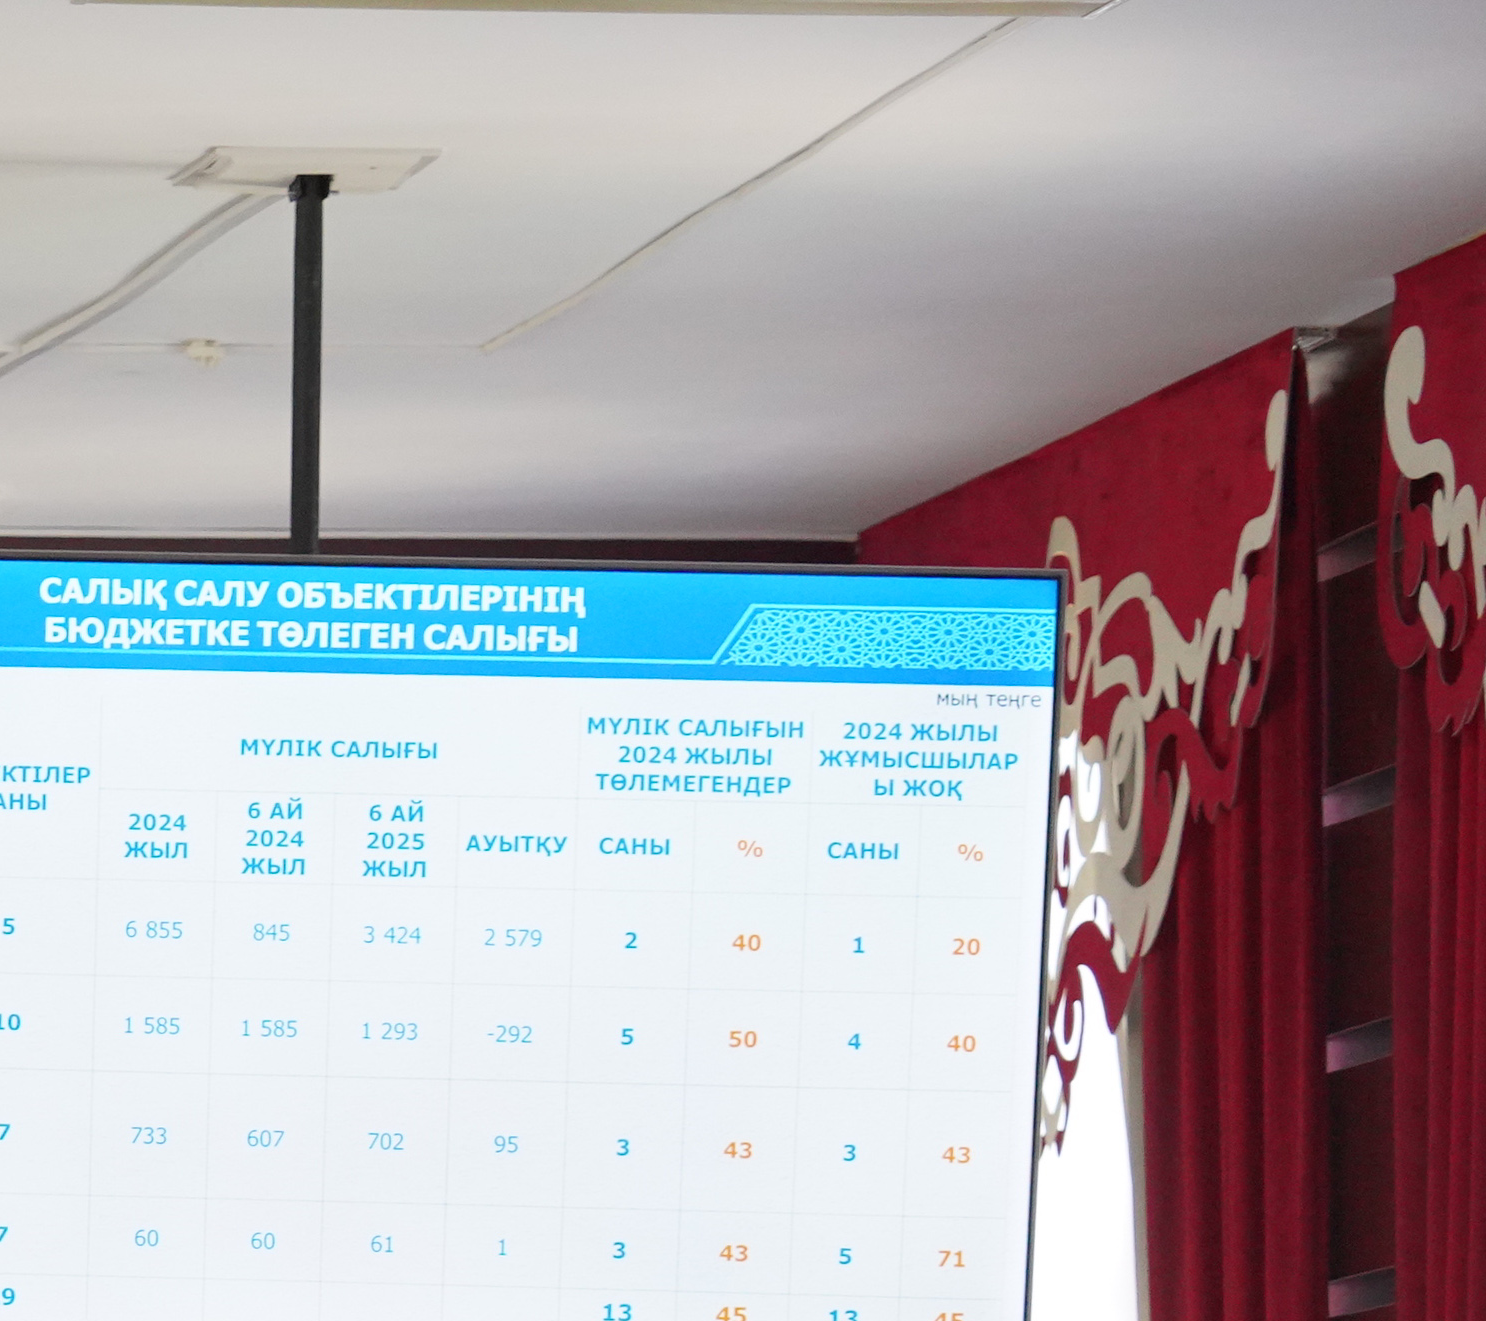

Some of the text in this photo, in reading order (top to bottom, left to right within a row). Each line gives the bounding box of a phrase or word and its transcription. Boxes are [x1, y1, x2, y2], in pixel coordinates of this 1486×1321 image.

[39, 577, 586, 619] САЛЫҚ САЛУ ОБЪЕКТІЛЕРІНІҢ
[45, 616, 578, 653] БЮДЖЕТКЕ ТӨЛЕГЕН САЛЫҒЫ
[936, 691, 1043, 709] мың теңге
[587, 716, 804, 739] МҮЛІК САЛЫҒЫН
[843, 721, 998, 743] 2024 ЖЫЛЫ
[240, 738, 438, 760] МҮЛІК САЛЫҒЫ
[618, 745, 773, 766] 2024 ЖЫЛЫ
[819, 749, 1019, 770] ЖҰМЫСШЫЛАР
[595, 773, 792, 798] ТӨЛЕМЕГЕНДЕР
[873, 778, 963, 802] Ы ЖОҚ
[247, 797, 303, 820] 6 АЙ
[369, 799, 424, 823] 6 АЙ
[128, 813, 187, 832] 2024
[245, 829, 304, 848] 2024
[366, 831, 425, 851] 2025
[465, 834, 568, 857] АУЫТҚУ
[598, 837, 671, 856] САНЫ
[124, 841, 188, 859] ЖЫЛ
[737, 839, 764, 858] %
[827, 841, 899, 860] САНЫ
[957, 843, 984, 862] %
[241, 857, 306, 876] ЖЫЛ
[362, 860, 427, 878] ЖЫЛ
[1, 917, 16, 936] 5
[252, 922, 291, 942] 845
[624, 931, 638, 950] 2
[732, 933, 762, 952] 40
[852, 936, 866, 954] 1
[952, 937, 981, 956] 20
[486, 1024, 533, 1044] -292
[620, 1027, 635, 1046] 5
[729, 1030, 758, 1048] 50
[847, 1033, 862, 1051] 4
[947, 1034, 977, 1053] 40
[131, 1126, 168, 1145] 733
[246, 1129, 285, 1148] 607
[367, 1131, 405, 1151] 702
[493, 1135, 519, 1154] 95
[616, 1138, 631, 1157] 3
[723, 1141, 753, 1160] 43
[843, 1144, 857, 1162] 3
[942, 1146, 971, 1164] 43
[134, 1228, 160, 1248] 60
[250, 1231, 276, 1251] 60
[370, 1234, 394, 1254] 61
[497, 1238, 508, 1257] 1
[612, 1241, 626, 1260] 3
[719, 1244, 749, 1263] 43
[838, 1247, 852, 1265] 5
[939, 1250, 966, 1268] 71
